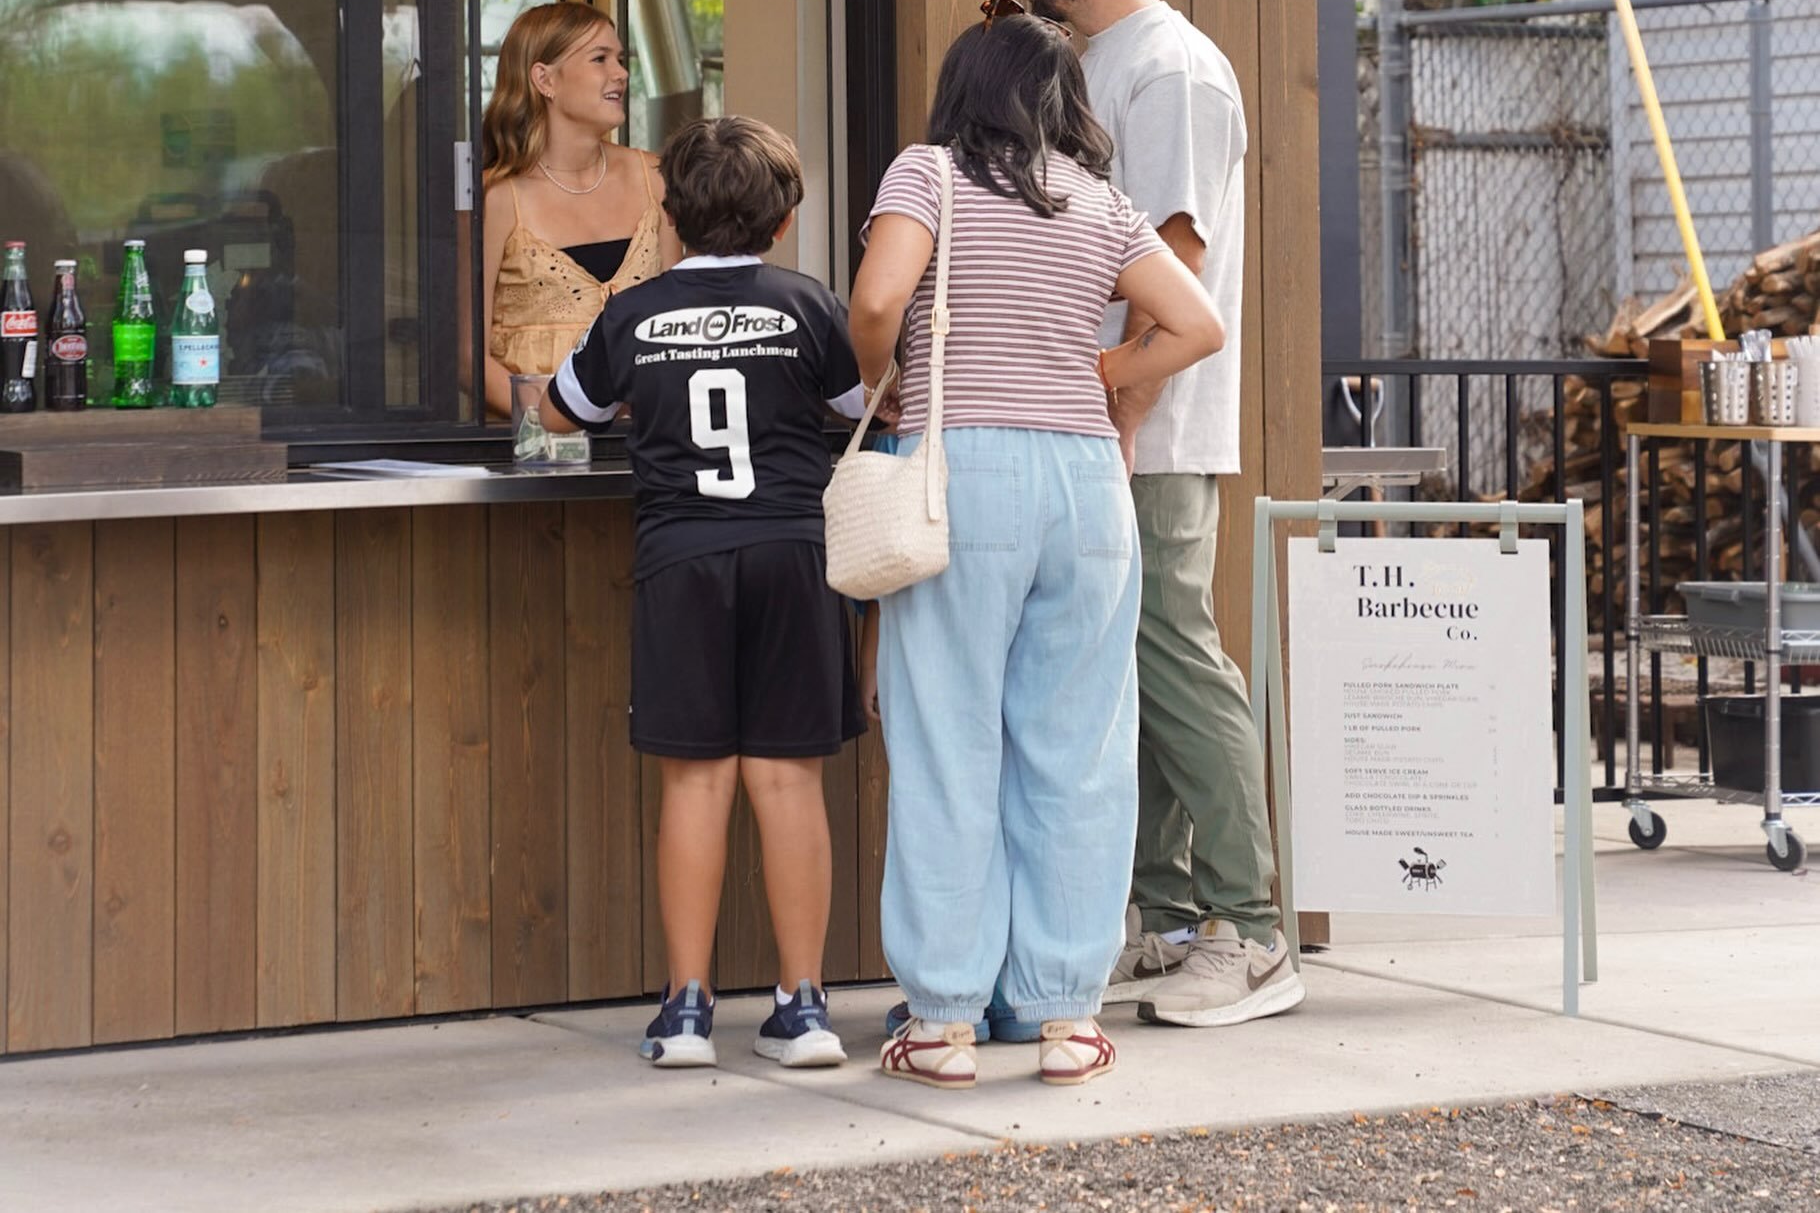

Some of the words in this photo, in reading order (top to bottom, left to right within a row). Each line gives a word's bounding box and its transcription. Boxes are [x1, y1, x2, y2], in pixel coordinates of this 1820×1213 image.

[635, 351, 667, 365] Great
[668, 347, 720, 361] Tasting
[722, 344, 798, 358] Lunchmeat
[688, 368, 756, 500] 9
[1353, 565, 1415, 587] T.H.
[1358, 597, 1479, 619] Barbecue
[1446, 625, 1478, 641] Co.
